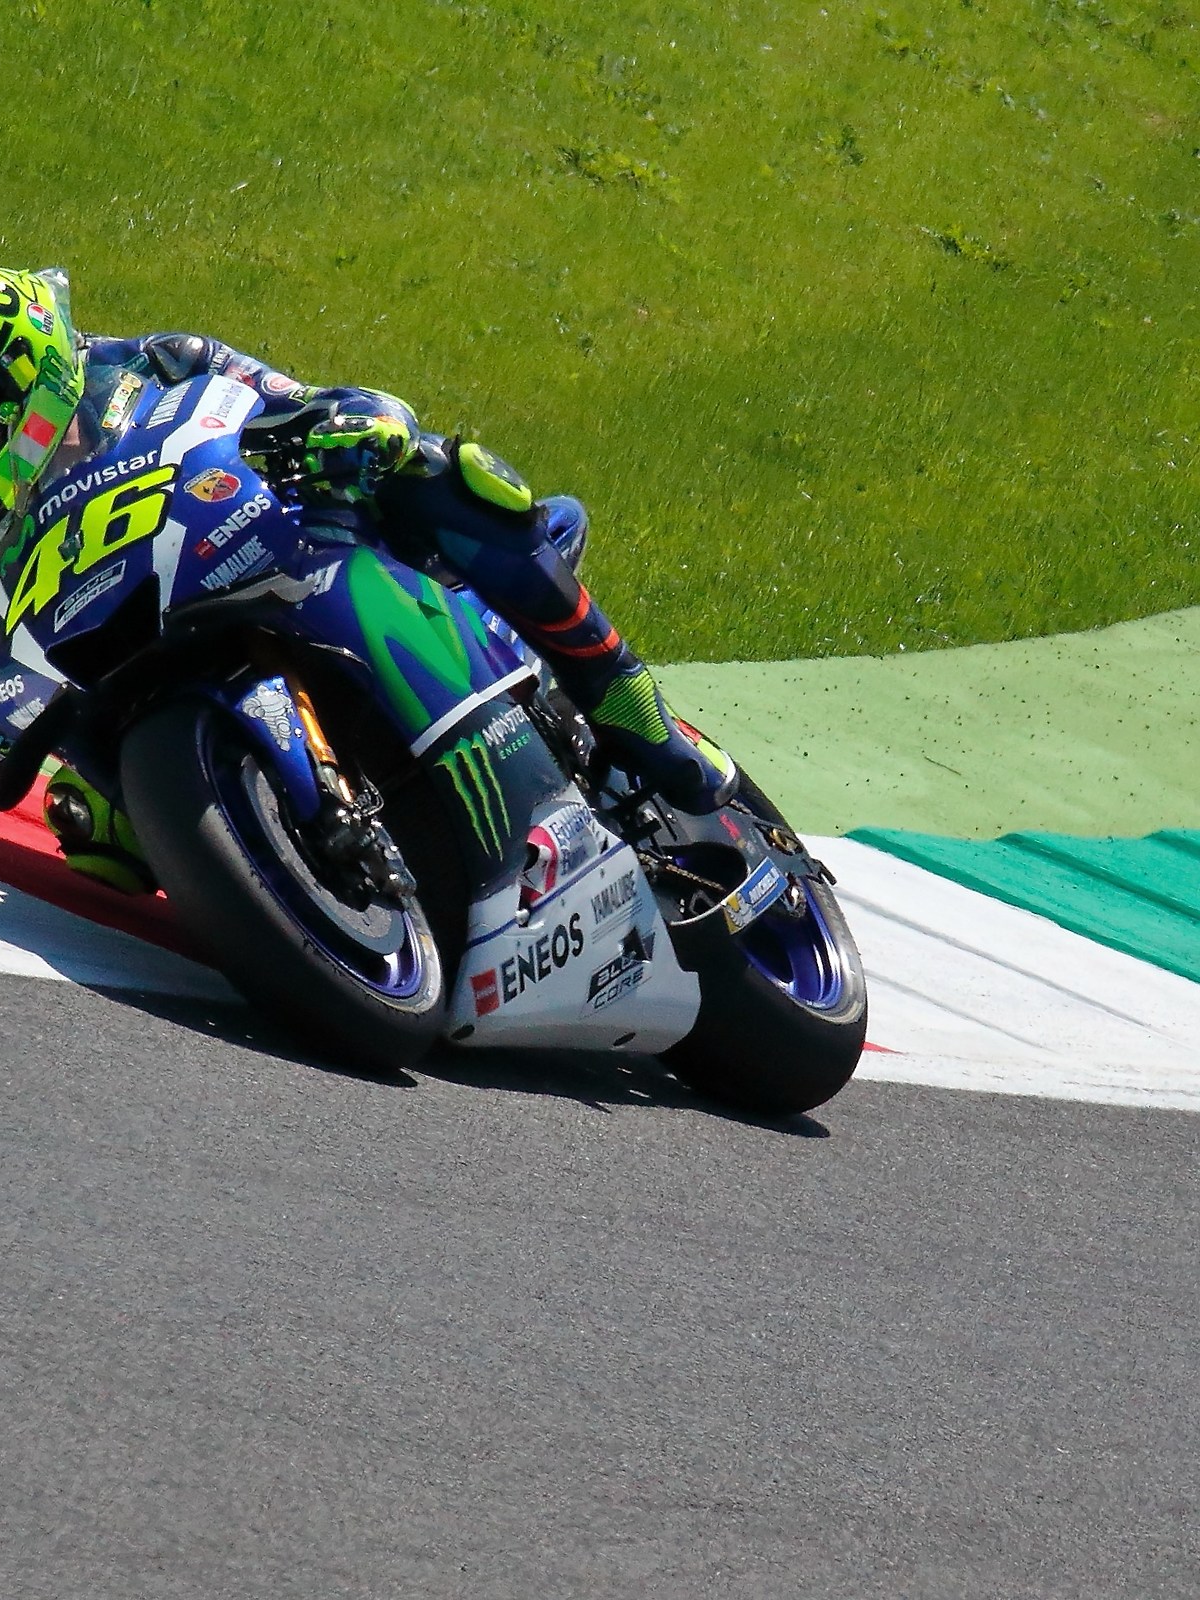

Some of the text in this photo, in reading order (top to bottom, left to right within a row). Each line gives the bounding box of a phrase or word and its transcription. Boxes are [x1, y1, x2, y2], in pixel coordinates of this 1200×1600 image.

[39, 450, 160, 525] movistar
[6, 465, 176, 636] 46
[207, 493, 272, 548] ENEOS
[482, 704, 531, 748] MONSTER
[500, 912, 585, 1004] ENEOS
[594, 966, 644, 1010] CORE
